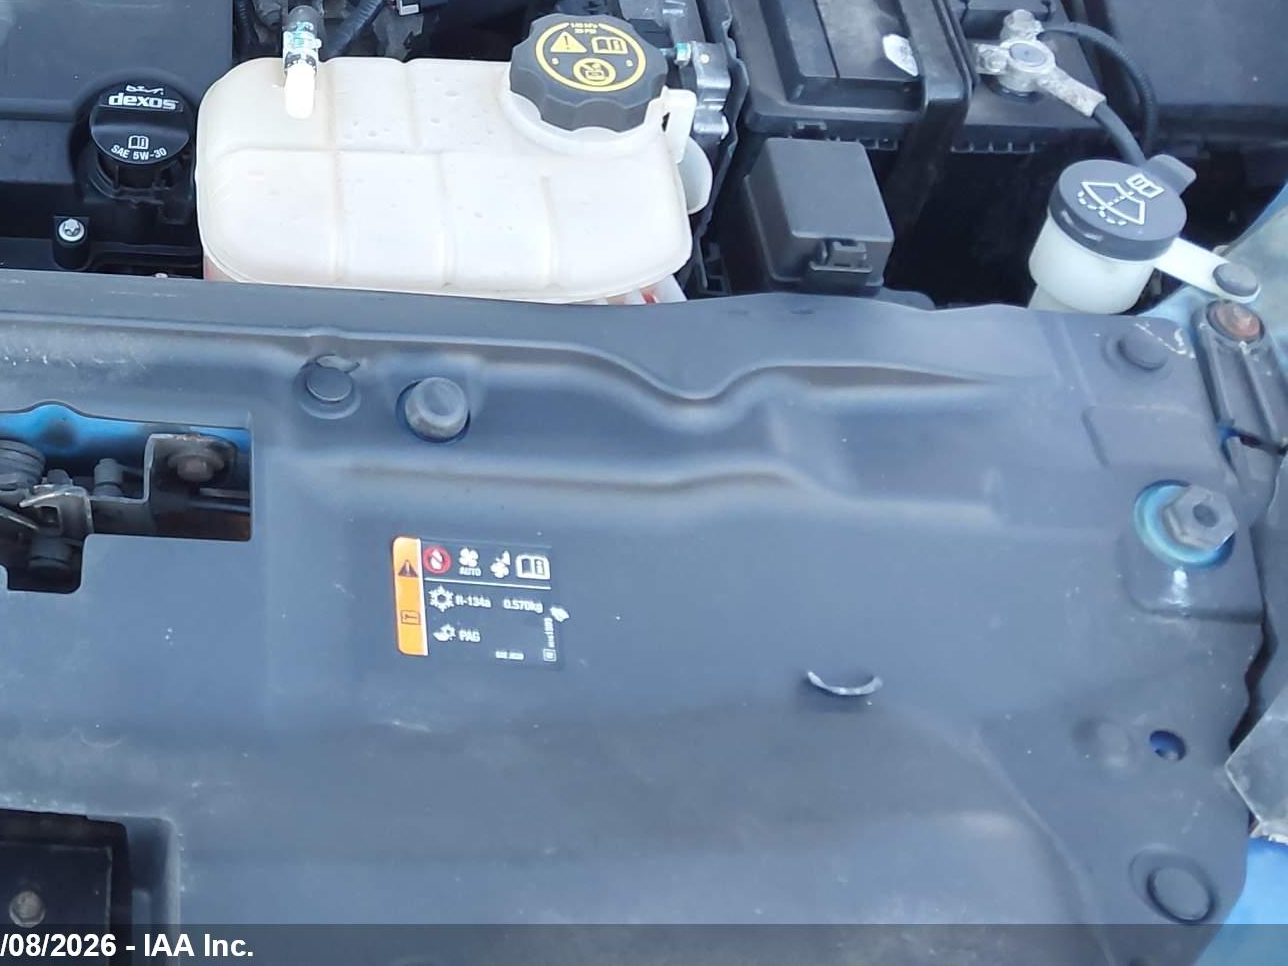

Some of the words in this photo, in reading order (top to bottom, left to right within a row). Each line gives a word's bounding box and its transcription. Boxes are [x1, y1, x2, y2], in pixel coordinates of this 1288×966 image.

[108, 92, 179, 110] dexos
[110, 144, 130, 159] SAE
[132, 147, 167, 161] 5W-30
[459, 566, 482, 577] AUTO
[455, 594, 492, 609] R-134a
[503, 599, 544, 614] 0.570kg
[458, 629, 481, 643] PAG
